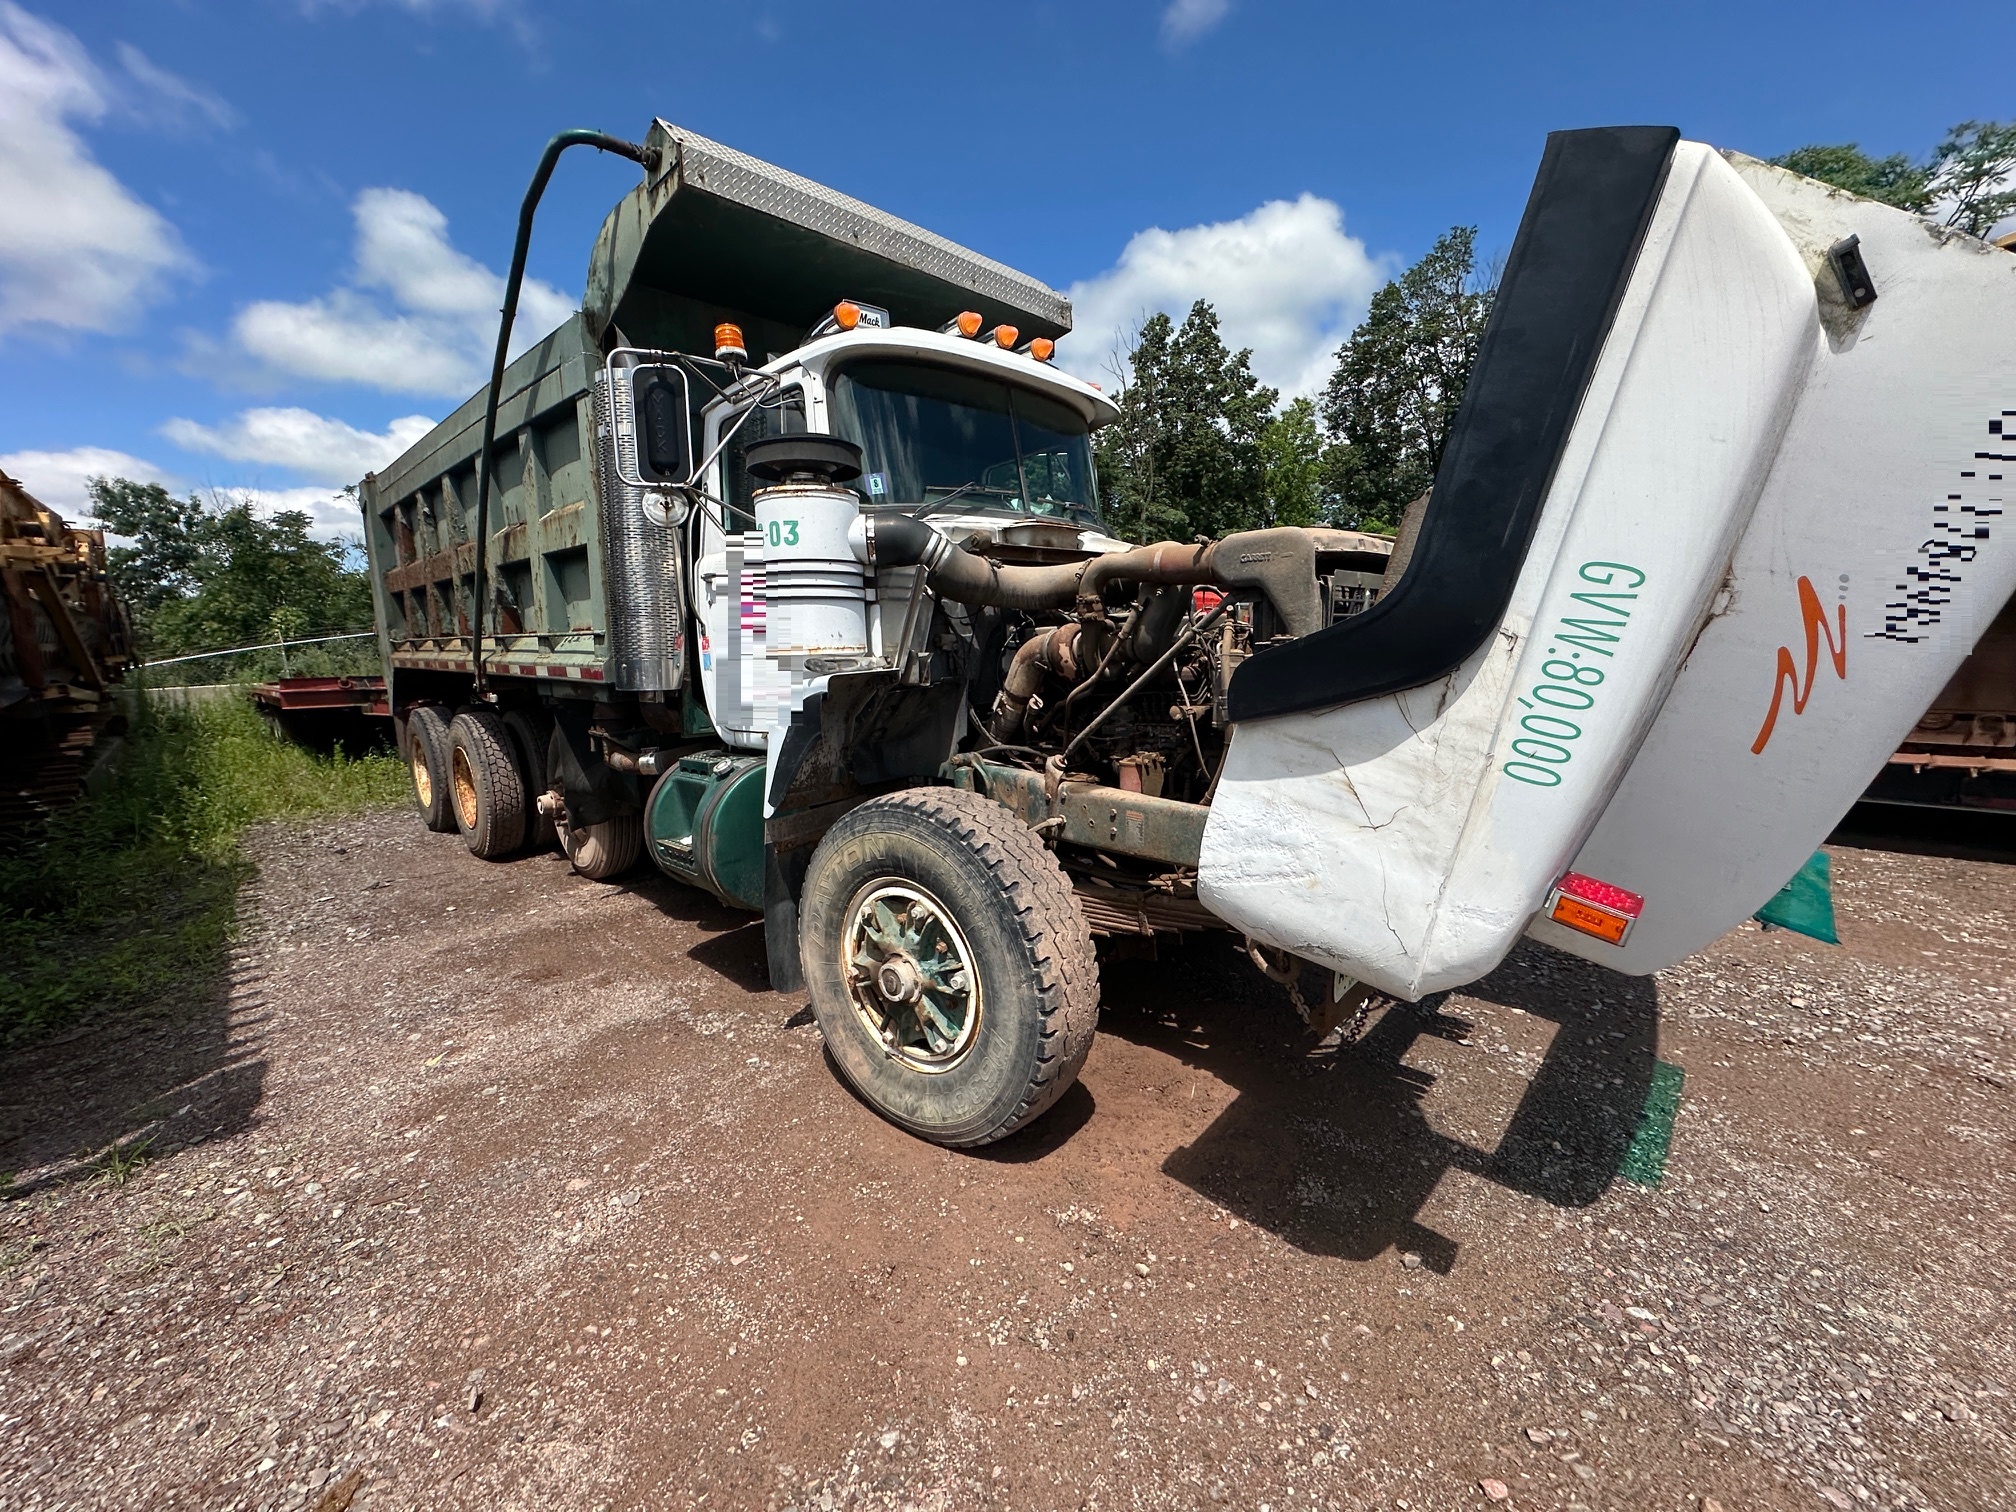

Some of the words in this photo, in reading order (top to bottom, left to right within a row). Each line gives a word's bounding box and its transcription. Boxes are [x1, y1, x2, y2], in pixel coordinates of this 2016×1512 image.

[859, 312, 880, 327] Mack
[652, 393, 668, 453] MACK
[757, 520, 799, 547] 03
[1502, 561, 1646, 787] GVW:80,000
[808, 834, 887, 948] DAYTON
